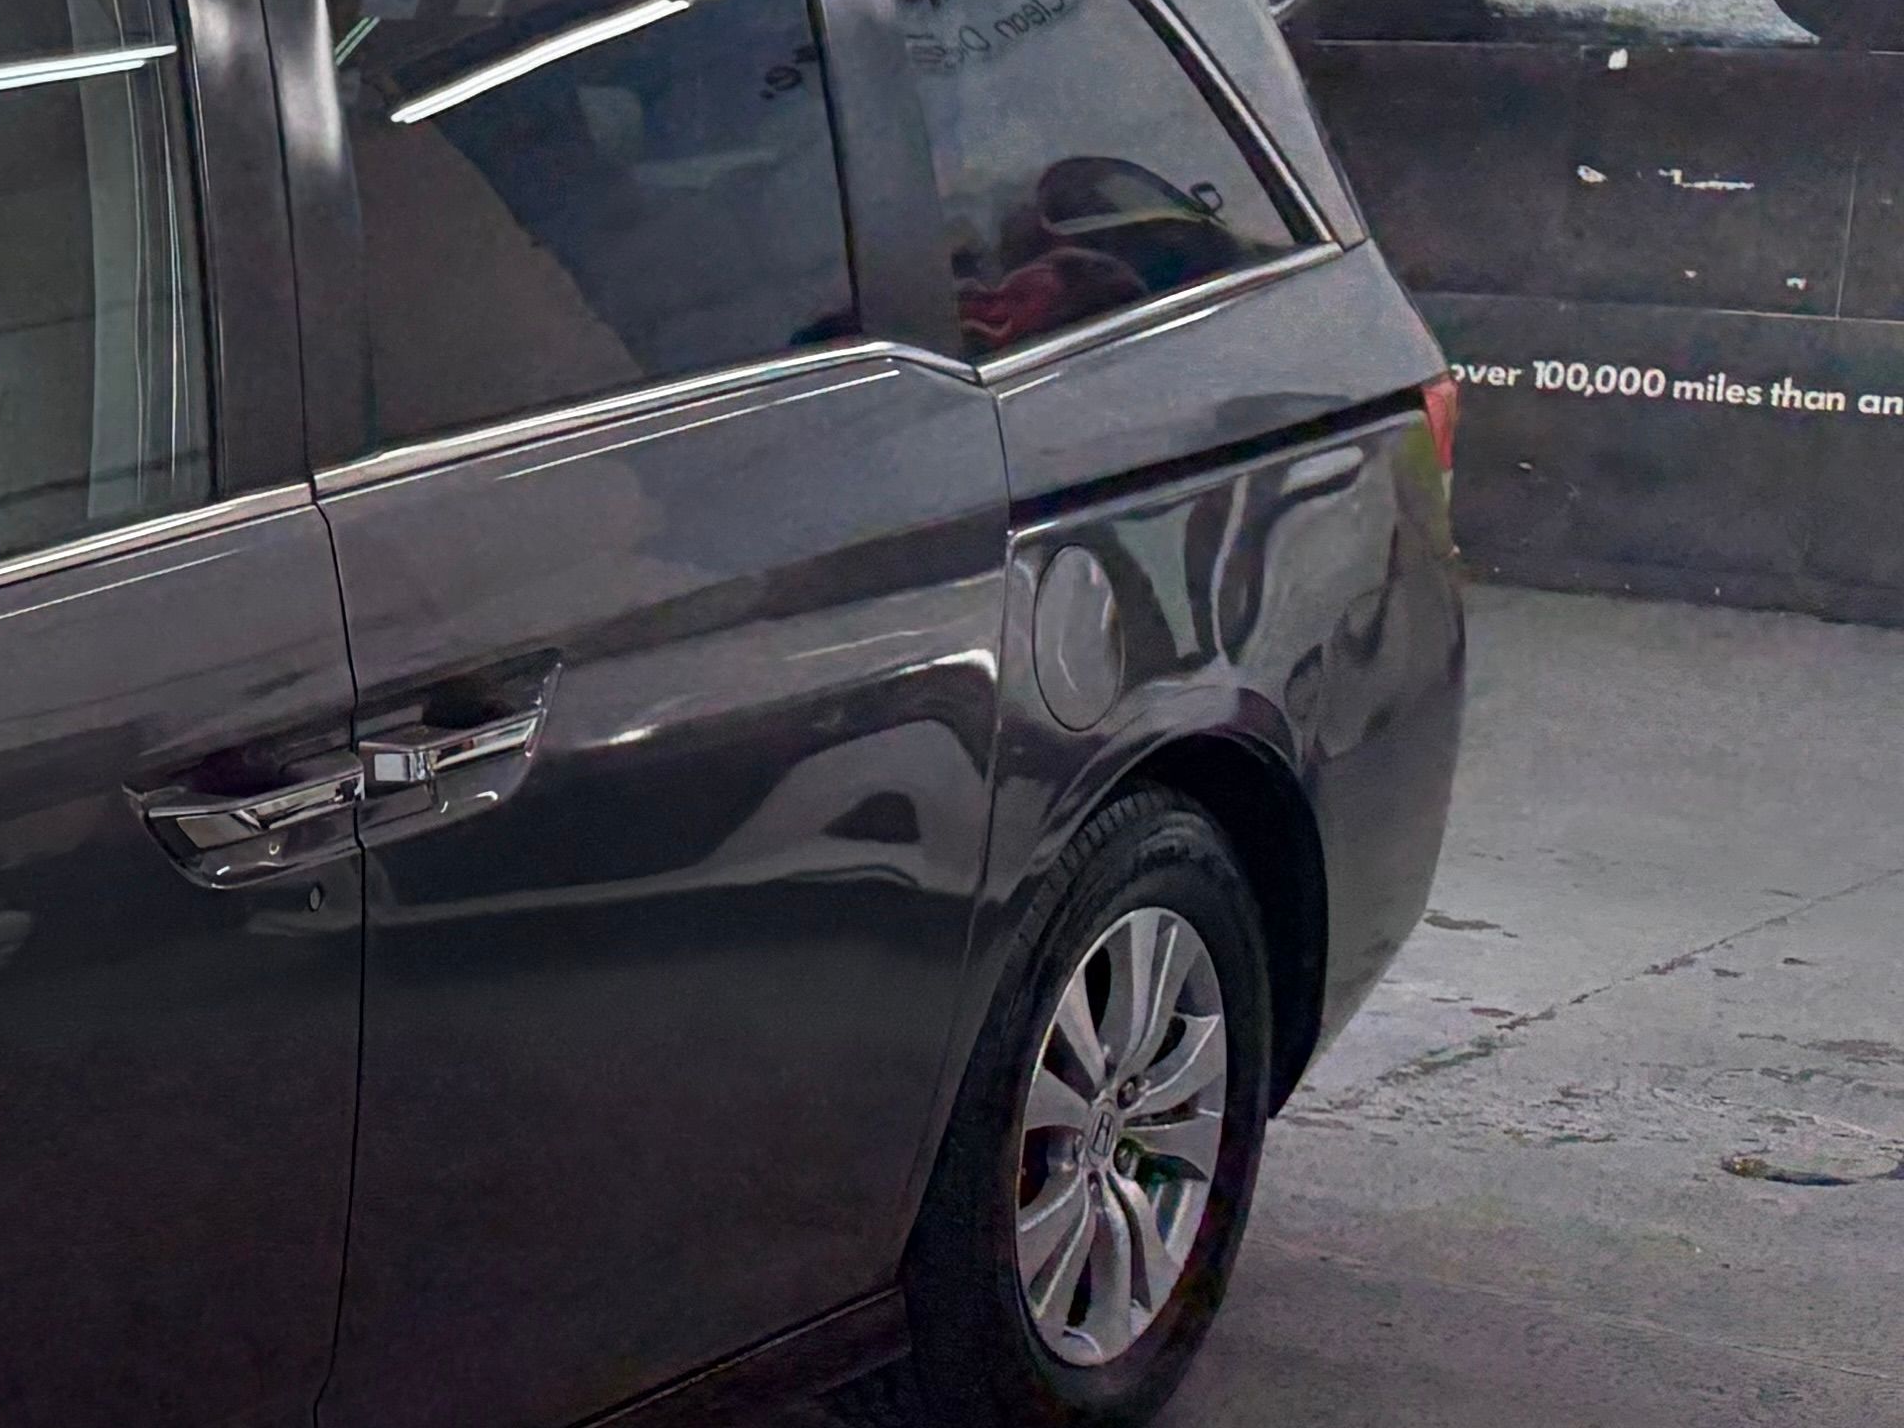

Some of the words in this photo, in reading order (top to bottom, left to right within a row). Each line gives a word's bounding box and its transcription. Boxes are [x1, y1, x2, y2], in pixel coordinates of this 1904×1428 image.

[1450, 363, 1523, 387] over
[1533, 360, 1667, 399] 100,000
[1672, 372, 1762, 406] miles
[1770, 377, 1847, 412] than
